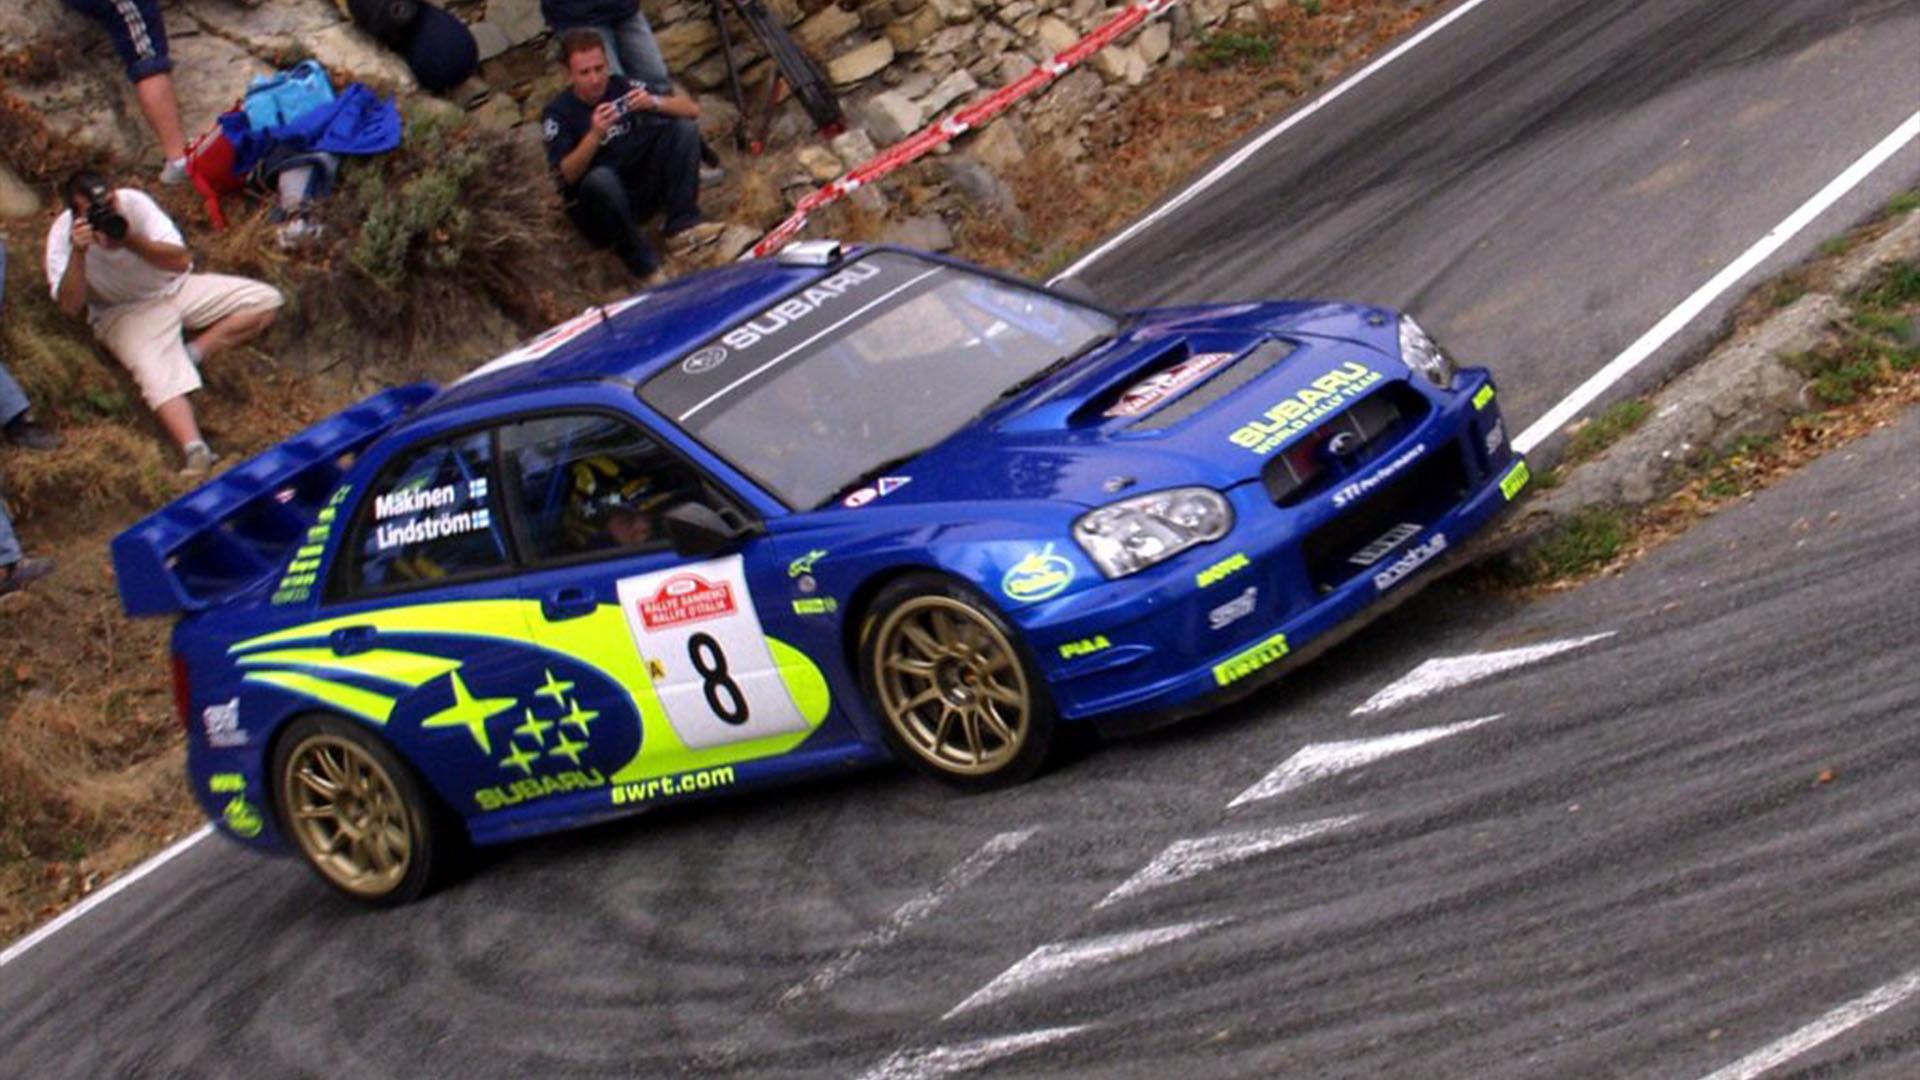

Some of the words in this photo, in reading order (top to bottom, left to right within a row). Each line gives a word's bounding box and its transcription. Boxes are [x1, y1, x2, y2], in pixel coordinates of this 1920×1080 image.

[721, 262, 881, 350] SUBARU
[1229, 361, 1368, 447] SUBARU
[1251, 421, 1308, 455] WORLD
[1306, 394, 1344, 423] RALLY
[1342, 371, 1383, 396] TEAM
[375, 484, 454, 519] Mäkinen
[376, 511, 471, 550] Lindström
[687, 631, 750, 726] 8
[475, 768, 605, 811] SUBARU
